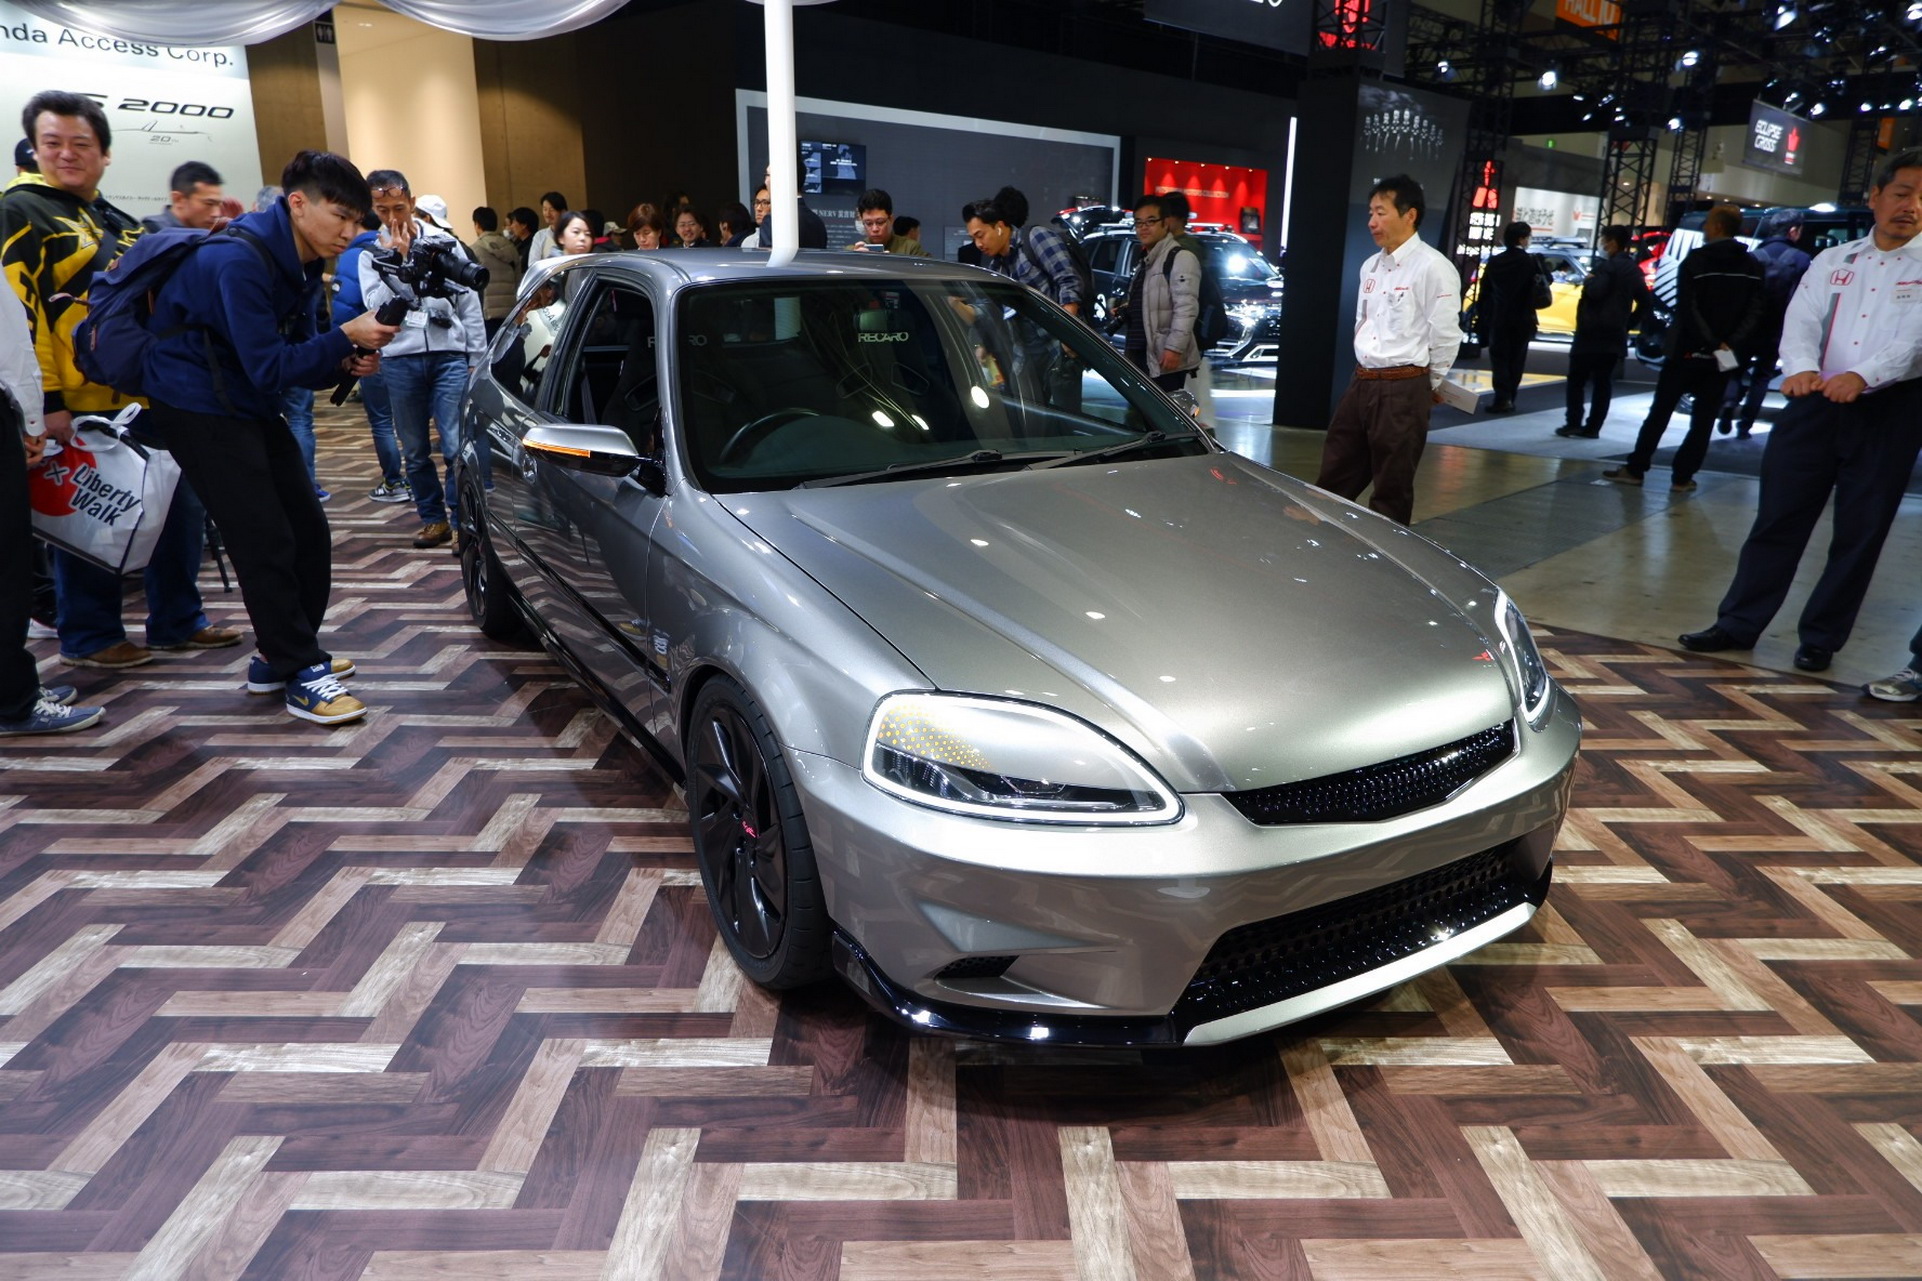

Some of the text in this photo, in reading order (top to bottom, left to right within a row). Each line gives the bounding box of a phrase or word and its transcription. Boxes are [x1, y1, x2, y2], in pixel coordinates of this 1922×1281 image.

[58, 28, 159, 57] Access
[858, 331, 909, 343] RECARO
[72, 464, 142, 513] Liberty
[70, 488, 122, 527] Walk
